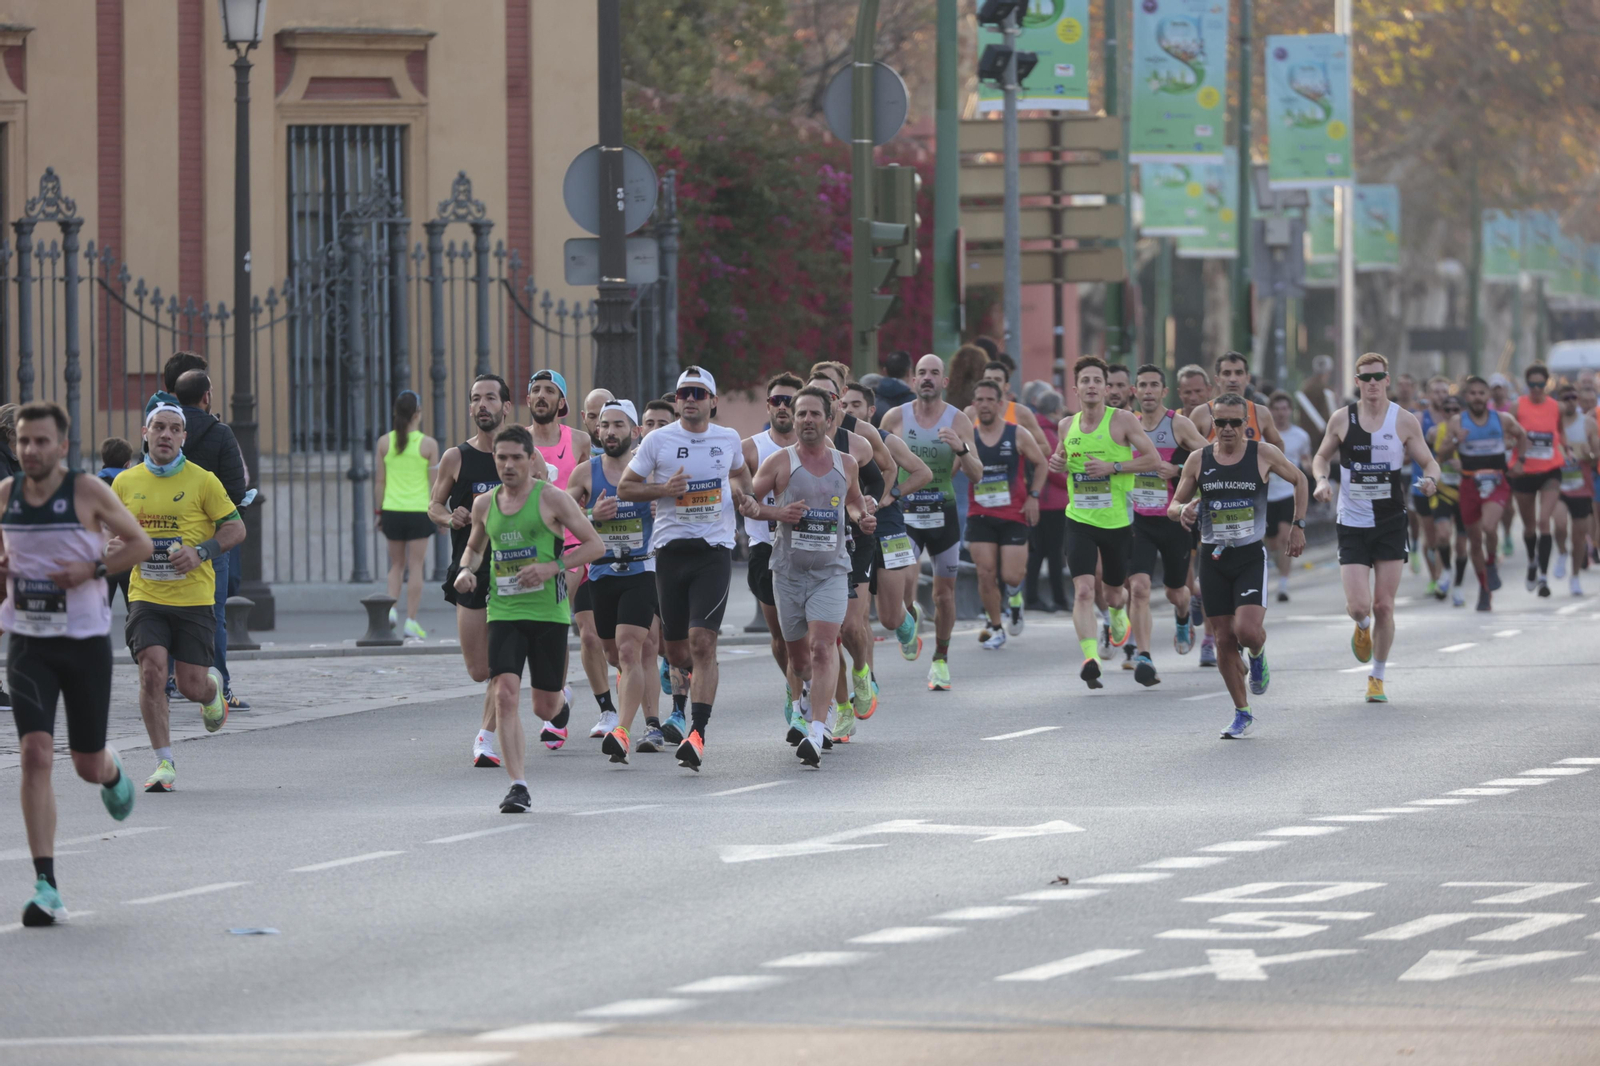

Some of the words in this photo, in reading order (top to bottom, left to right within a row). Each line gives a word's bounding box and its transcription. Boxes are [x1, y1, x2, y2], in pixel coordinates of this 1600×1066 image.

[691, 481, 717, 490] ZURICH
[1203, 479, 1224, 492] FERMÍN
[1224, 481, 1256, 491] KACHOPOS
[692, 496, 708, 504] 3737
[615, 511, 637, 519] URICH
[809, 510, 834, 518] ZURICH
[139, 519, 180, 529] EVILLA
[611, 524, 627, 533] 1170
[808, 523, 824, 532] 2638
[500, 530, 523, 541] GUÍA
[151, 553, 167, 561] 1963
[503, 549, 532, 559] ZURICH
